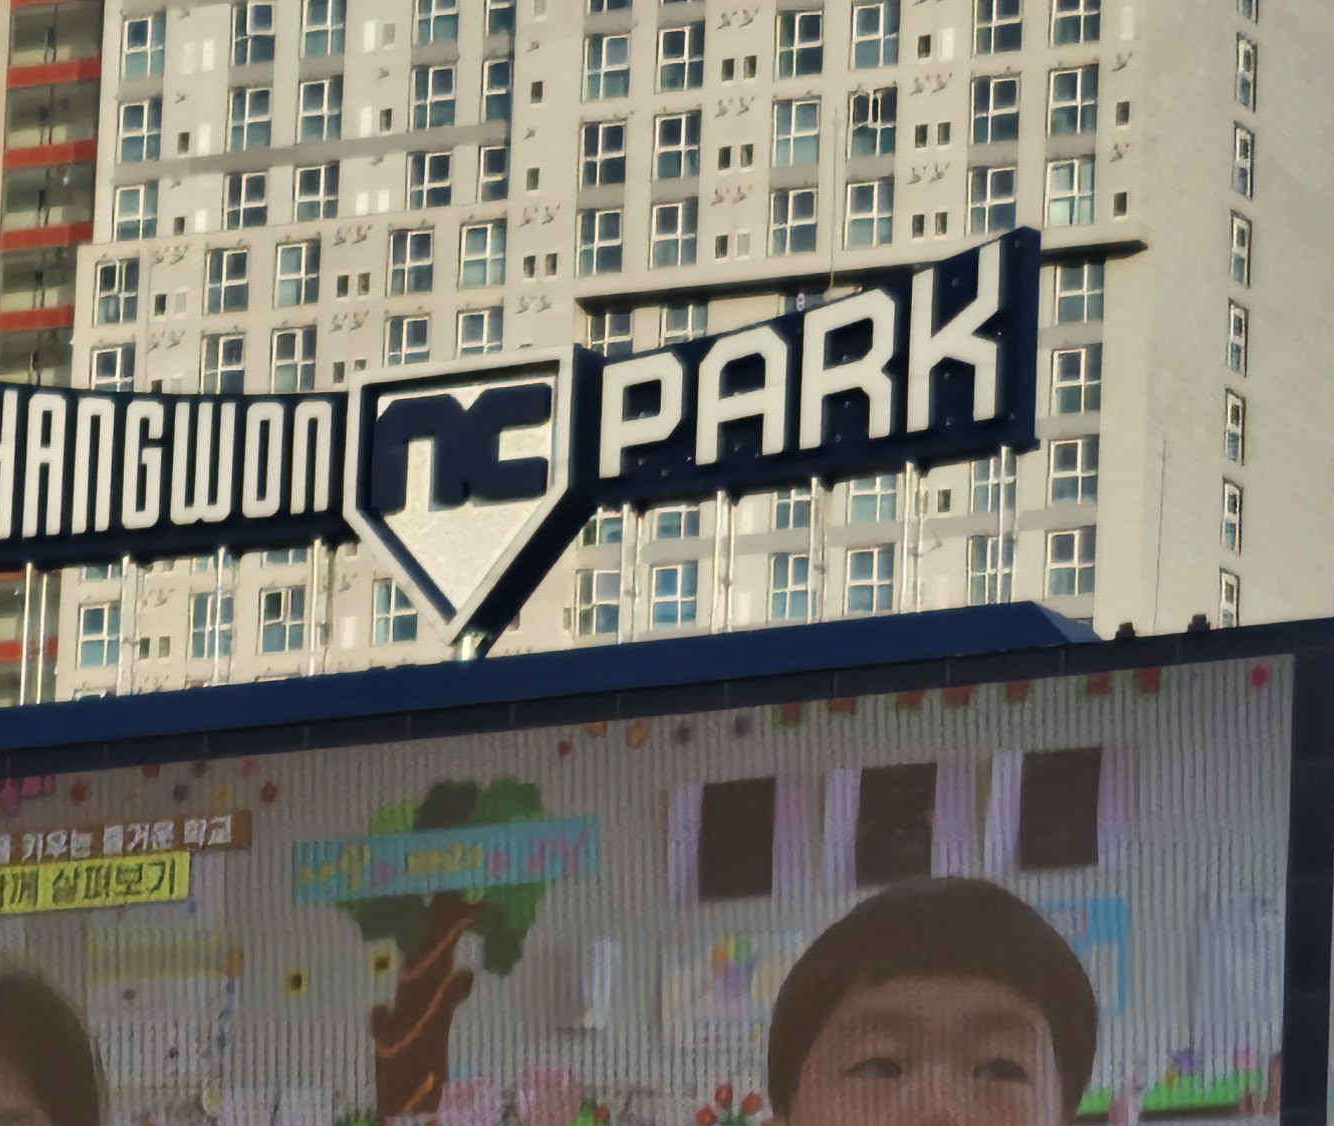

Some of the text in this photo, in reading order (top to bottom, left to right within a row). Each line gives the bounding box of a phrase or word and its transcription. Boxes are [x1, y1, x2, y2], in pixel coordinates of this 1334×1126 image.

[599, 239, 1004, 478] PARK
[183, 814, 232, 848] 학교
[51, 856, 176, 905] 살펴보기
